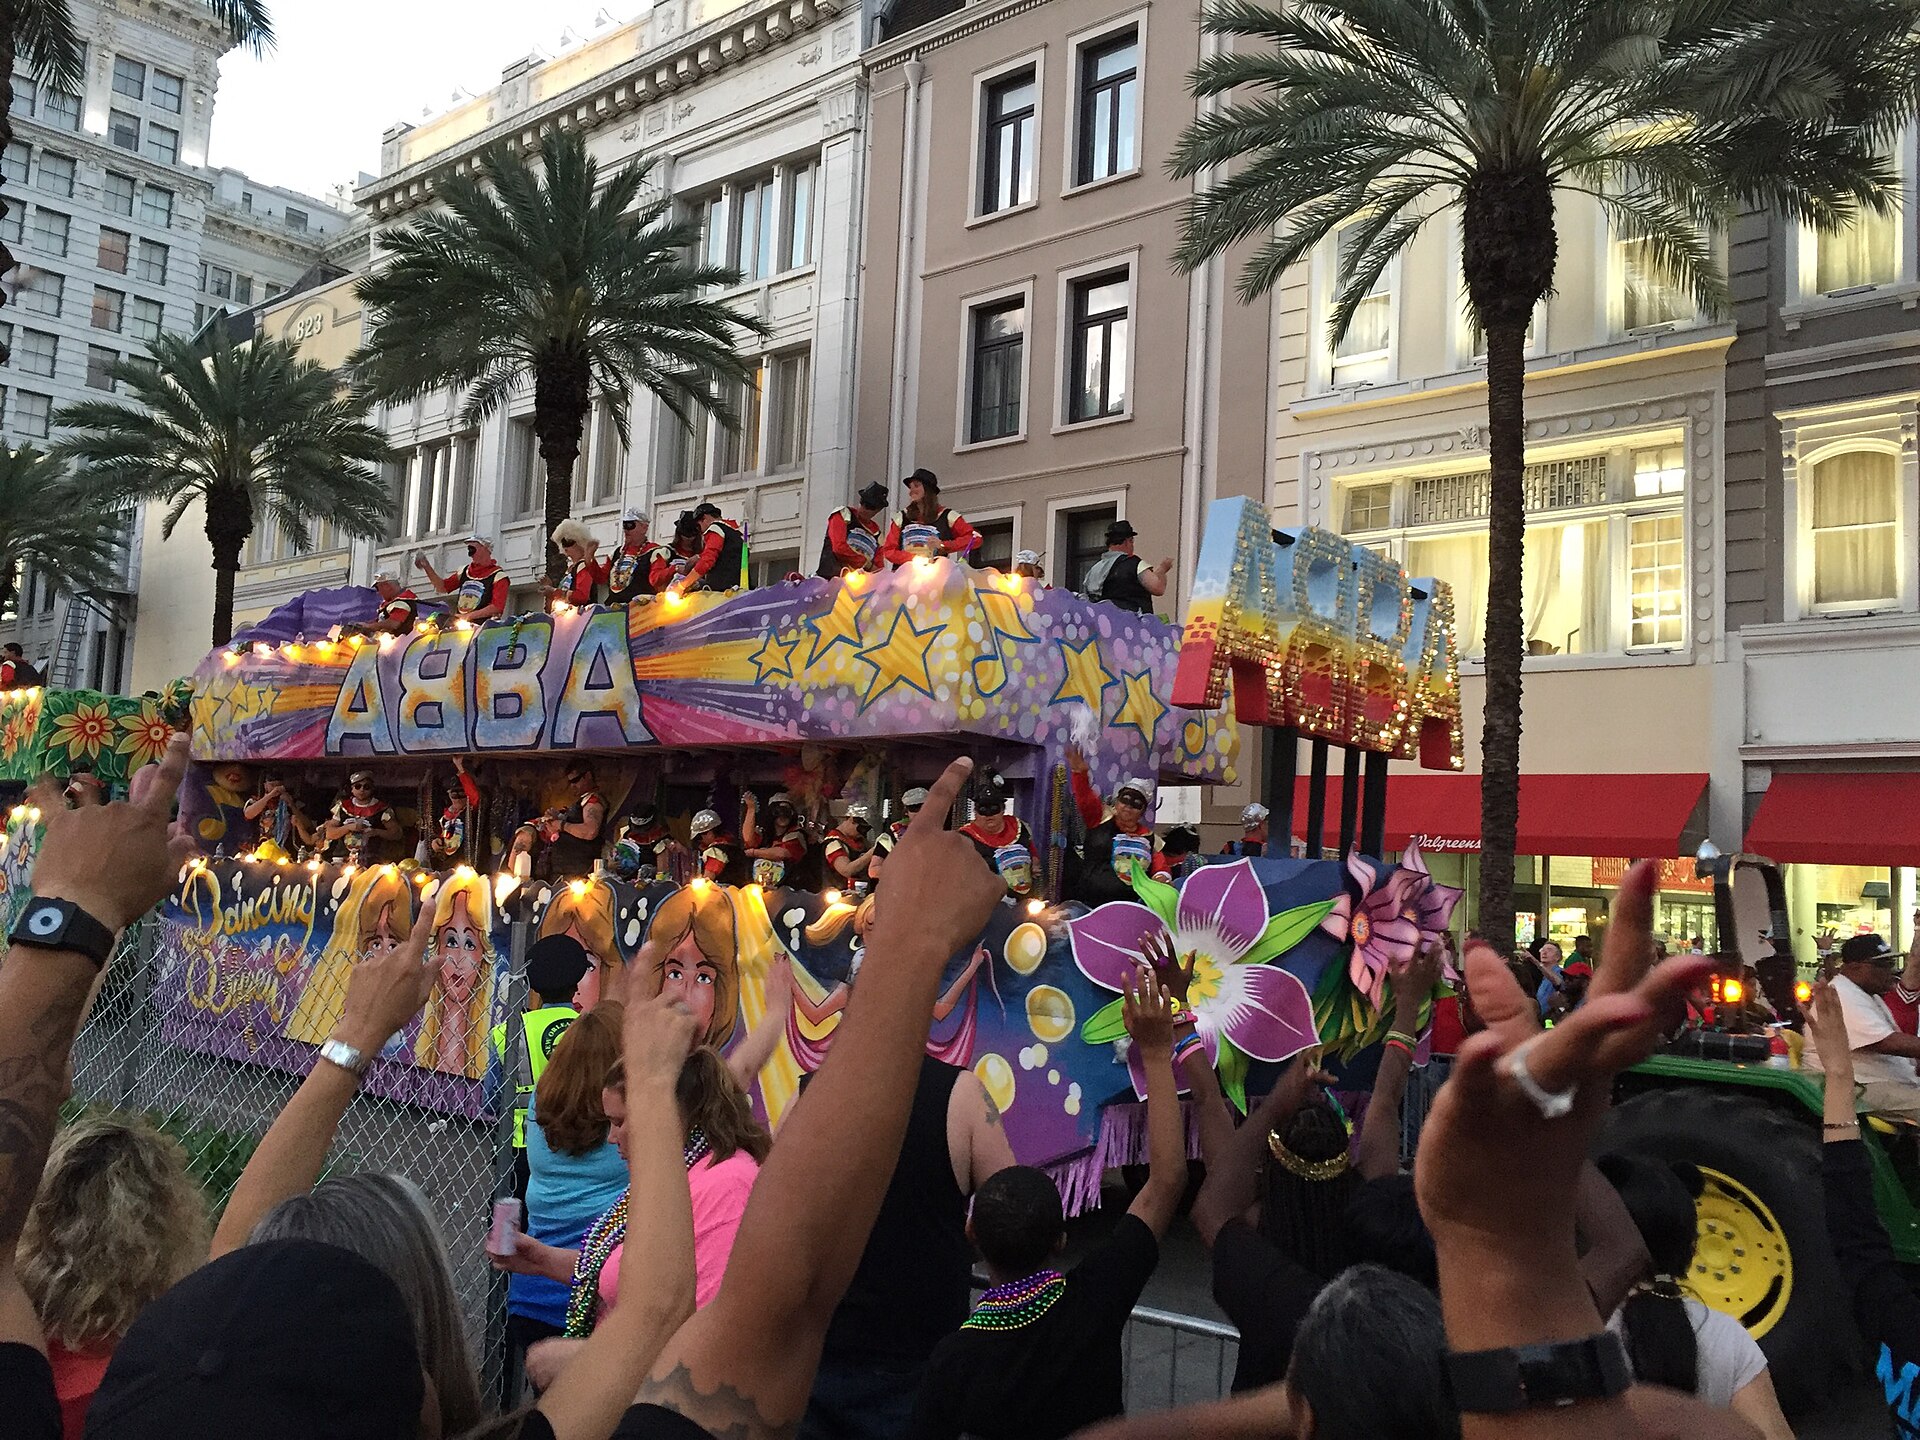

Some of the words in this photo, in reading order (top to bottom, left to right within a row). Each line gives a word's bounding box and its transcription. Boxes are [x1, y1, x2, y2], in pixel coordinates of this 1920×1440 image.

[296, 313, 323, 341] 823
[324, 606, 655, 756] ABBA
[1170, 495, 1464, 771] ABBA
[1409, 833, 1481, 852] Walgreens
[181, 856, 320, 974] Dancing
